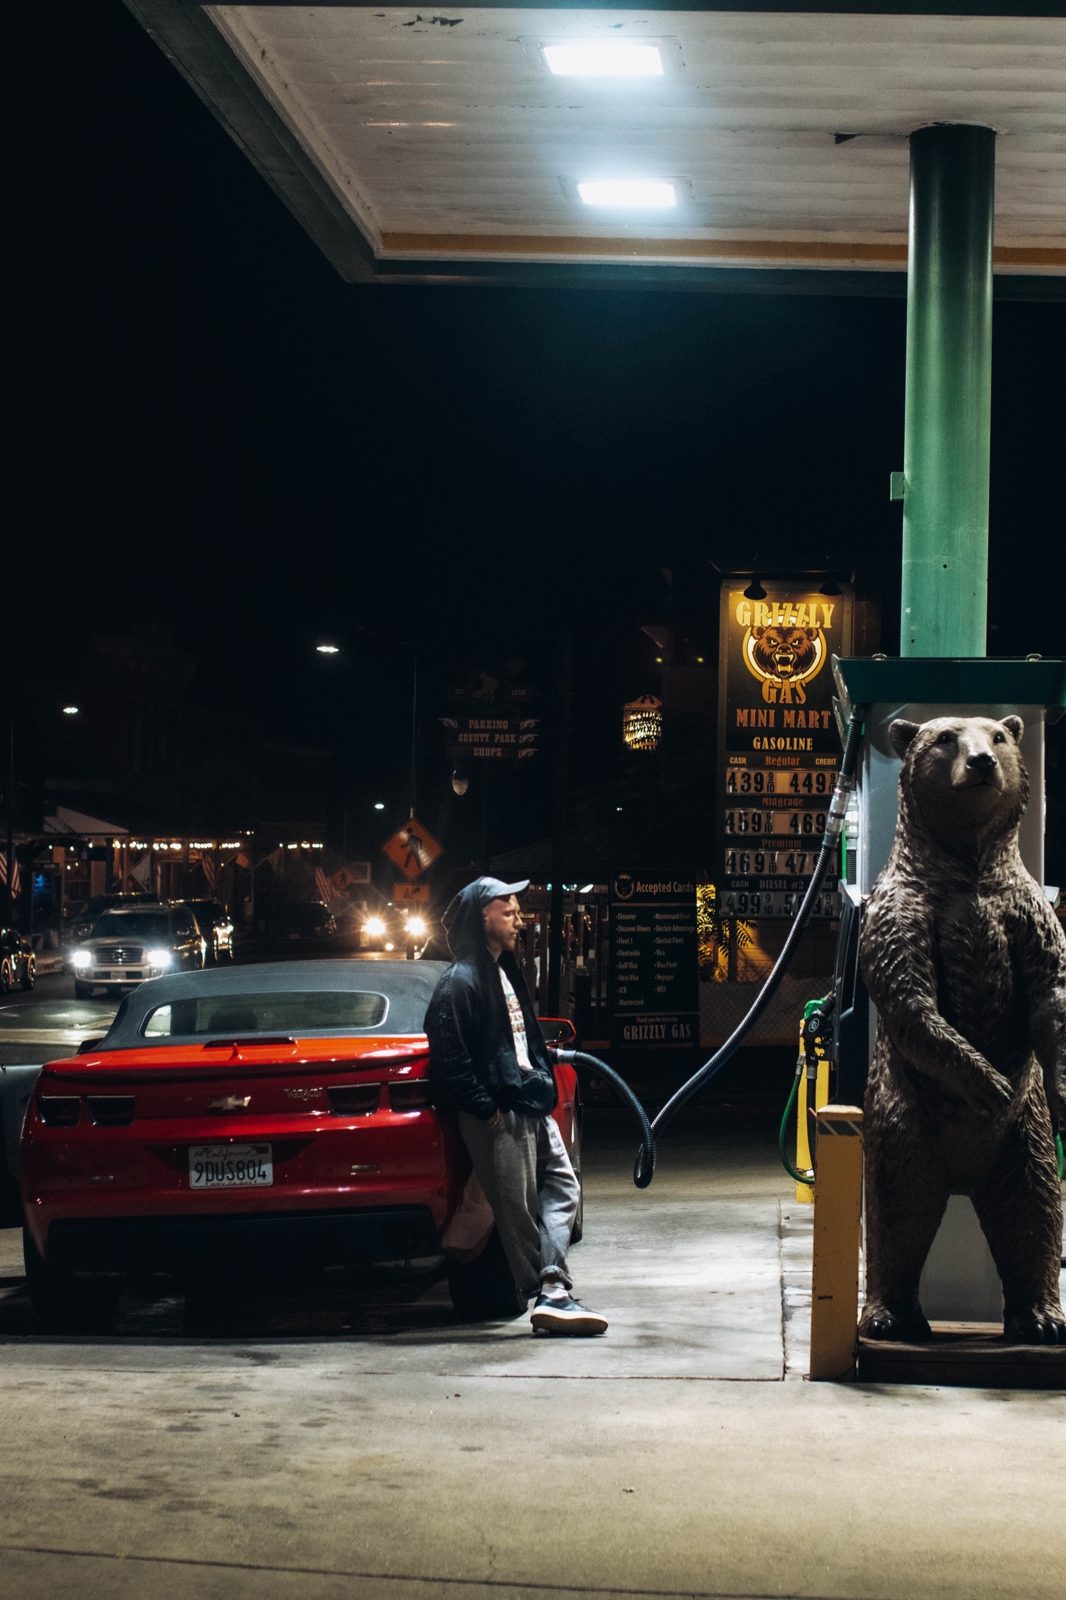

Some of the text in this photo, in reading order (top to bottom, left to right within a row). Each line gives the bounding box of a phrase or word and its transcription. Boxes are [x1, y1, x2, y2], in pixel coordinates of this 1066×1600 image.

[735, 601, 835, 629] GRIZZLY
[761, 678, 808, 705] GAS
[468, 719, 508, 729] PARKING
[736, 708, 831, 729] MINI MART
[457, 732, 516, 743] COUNTY PARK
[752, 736, 814, 751] GASOLINE
[473, 747, 502, 757] SHOPS
[729, 755, 837, 767] CASH Regular CREDIT
[761, 796, 804, 807] Midgrade
[761, 838, 802, 849] Premium
[636, 881, 694, 896] Accepted Cards
[759, 879, 787, 889] DIESEL
[791, 880, 804, 889] #2
[623, 1024, 691, 1041] GRIZZLY GAS
[194, 1160, 267, 1183] 9DUS804
